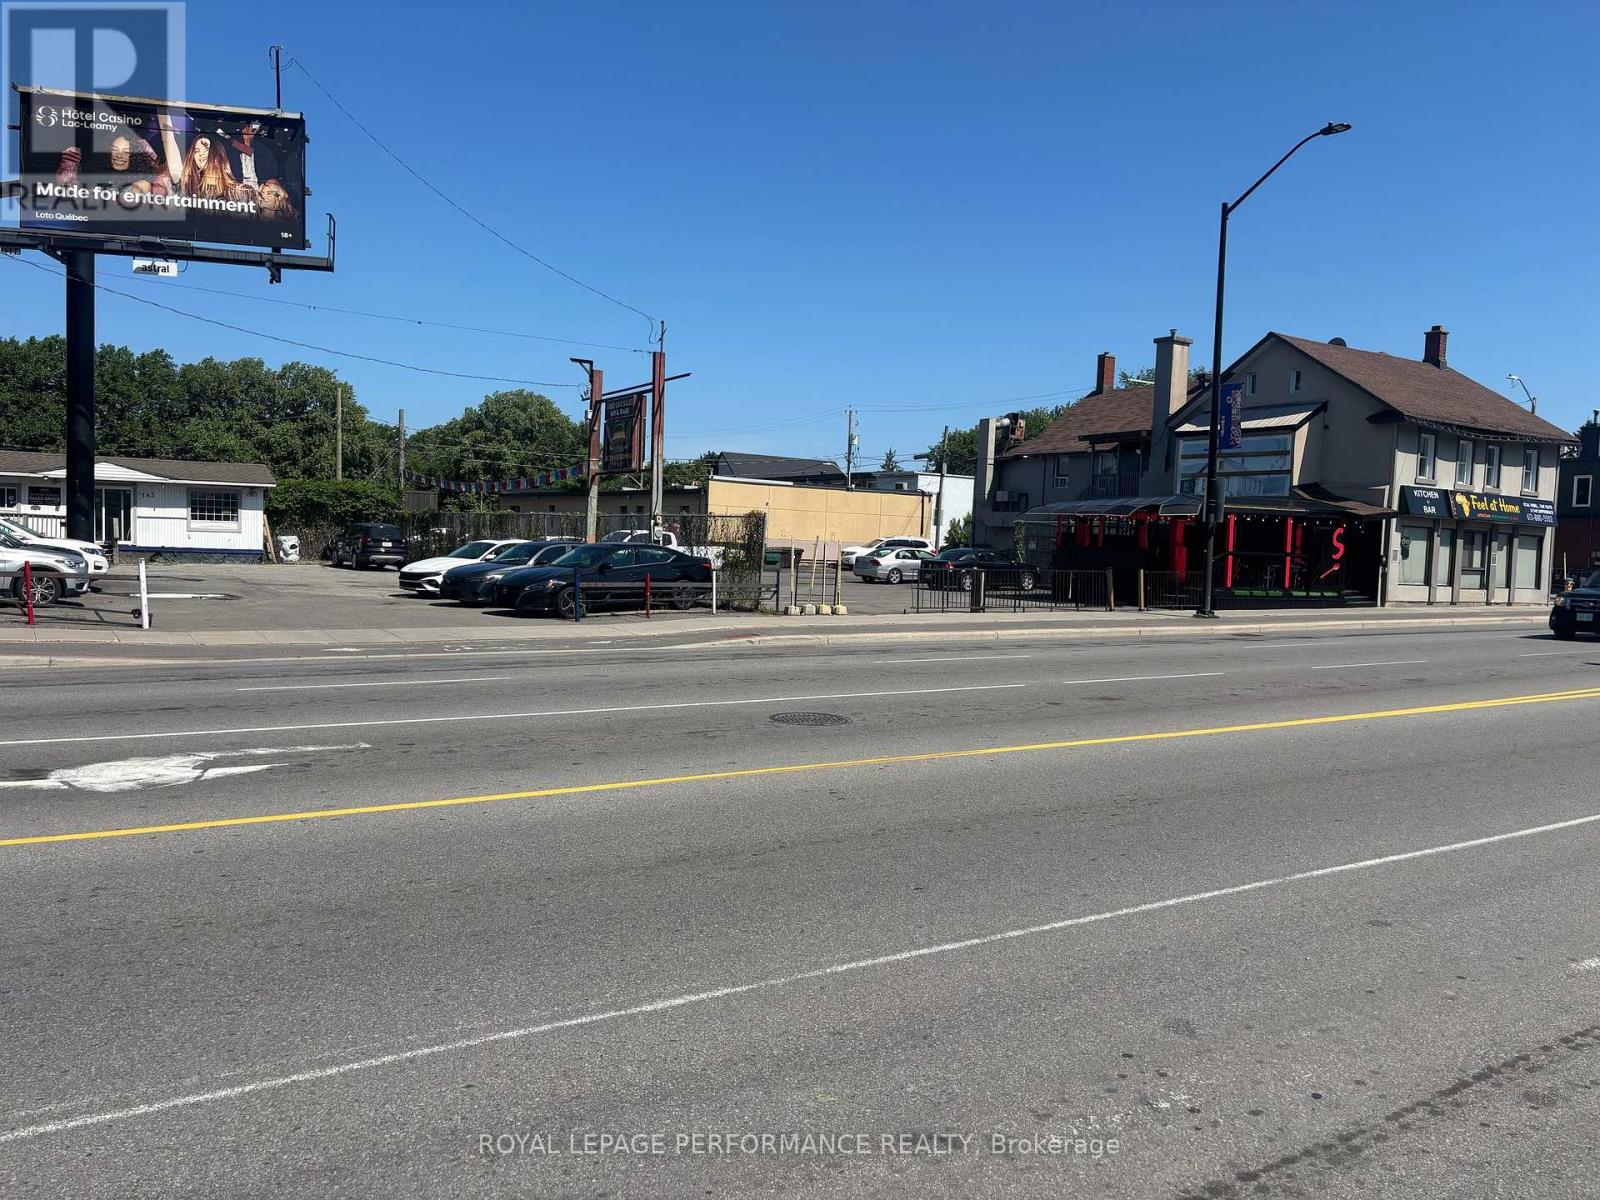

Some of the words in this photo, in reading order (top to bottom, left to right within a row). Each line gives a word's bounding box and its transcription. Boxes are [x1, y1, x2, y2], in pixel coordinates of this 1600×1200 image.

[61, 108, 96, 121] Hôtel
[98, 112, 142, 126] Casino
[61, 119, 117, 132] Lac-Leamy
[36, 181, 90, 200] Made
[93, 187, 120, 201] for
[123, 189, 256, 213] entertainment
[35, 211, 54, 220] Loto
[55, 212, 89, 222] Québec
[141, 262, 170, 273] astral
[1413, 489, 1439, 499] KITCHEN
[1423, 505, 1437, 514] BAR
[1470, 494, 1489, 510] Feel
[1489, 498, 1498, 512] at
[1499, 498, 1521, 514] Home
